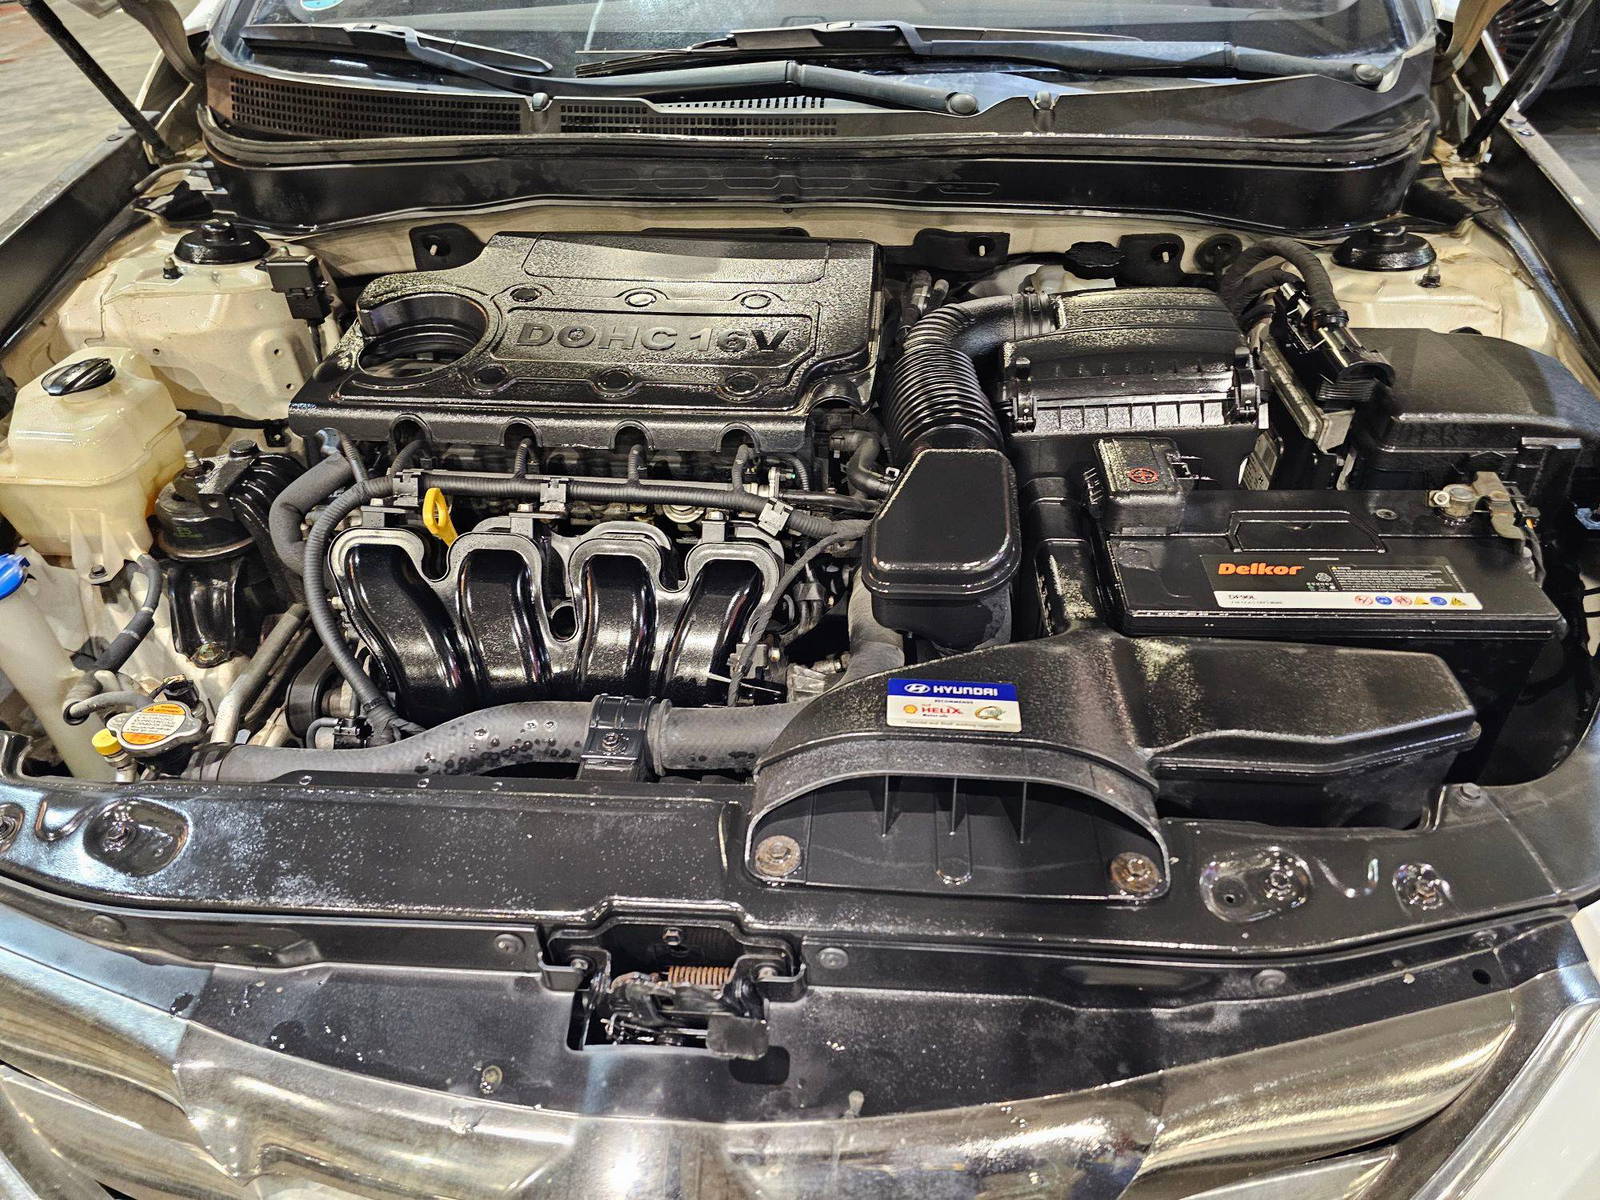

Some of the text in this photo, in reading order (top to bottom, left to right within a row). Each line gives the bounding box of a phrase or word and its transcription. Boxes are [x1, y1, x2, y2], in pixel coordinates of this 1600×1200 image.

[516, 322, 790, 352] DOHC 16V
[1218, 562, 1304, 575] Delkor
[933, 685, 998, 696] HYUNDAI
[921, 706, 963, 715] HELIX
